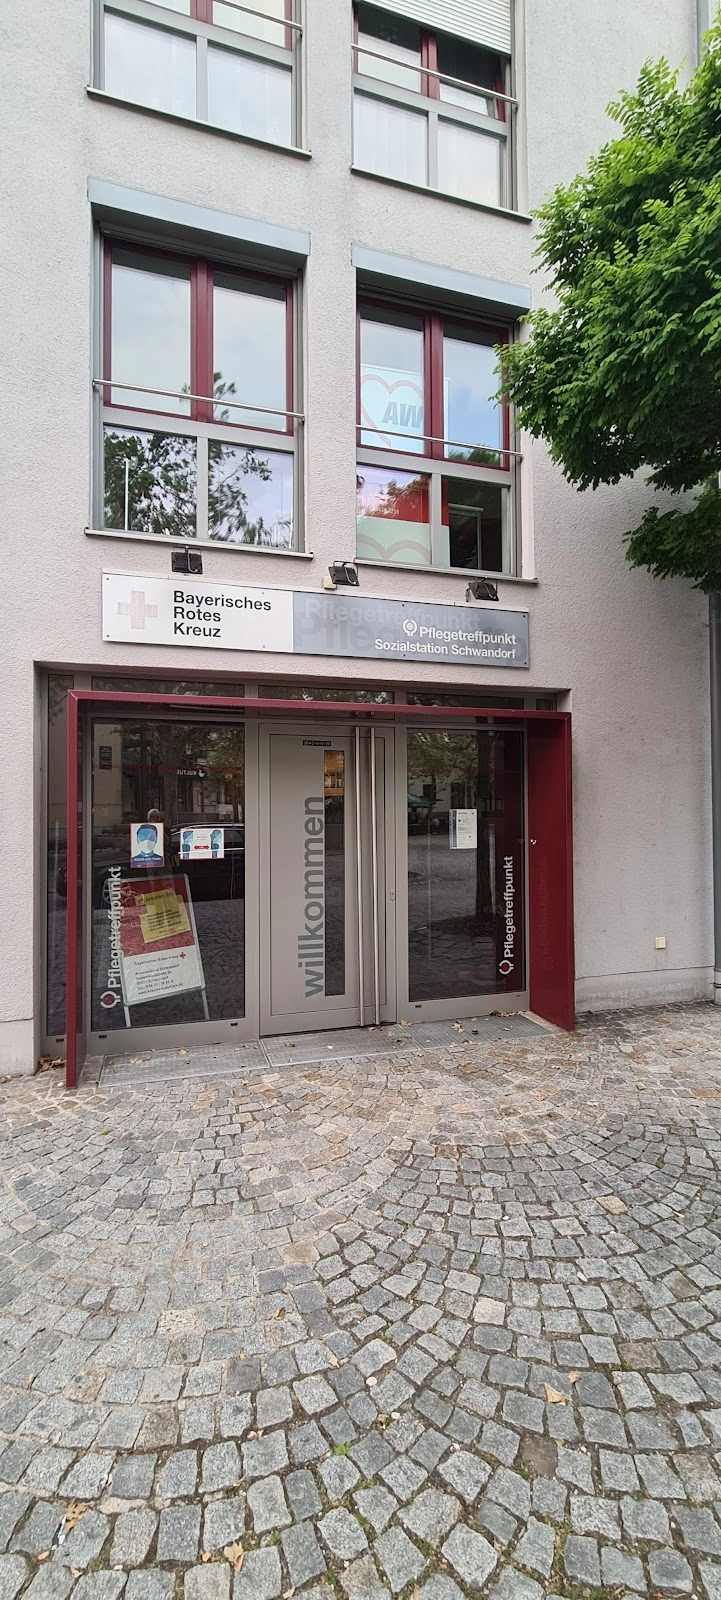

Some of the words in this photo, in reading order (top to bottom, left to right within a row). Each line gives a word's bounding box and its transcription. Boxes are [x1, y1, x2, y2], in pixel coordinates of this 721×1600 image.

[173, 589, 272, 612] Bayerisches
[173, 606, 221, 622] Rotes
[173, 622, 221, 638] Kreuz
[419, 626, 517, 646] Pflegetreffpunkt
[374, 639, 449, 655] Sozialstation
[451, 645, 516, 659] Schwandorf
[298, 796, 324, 998] willkommen
[503, 855, 515, 959] Pflegetreffpunkt
[108, 866, 124, 988] Pflegetreffpunkt
